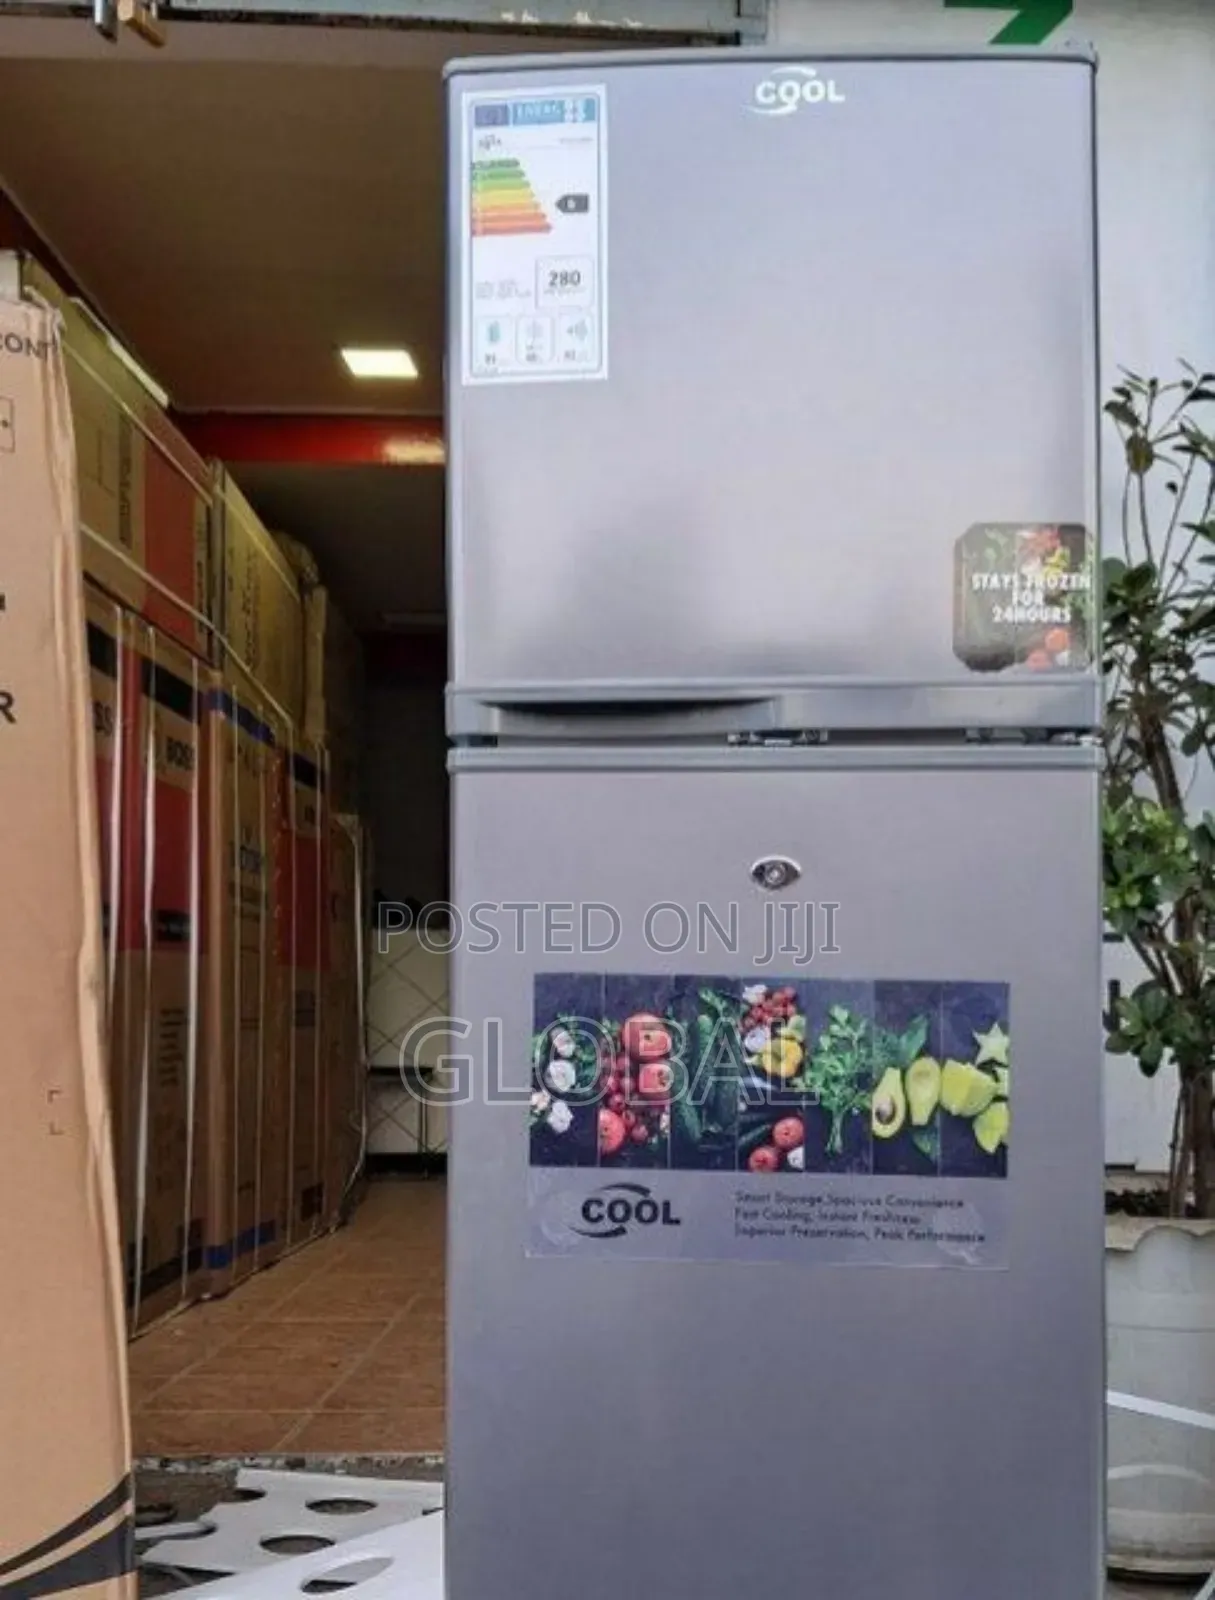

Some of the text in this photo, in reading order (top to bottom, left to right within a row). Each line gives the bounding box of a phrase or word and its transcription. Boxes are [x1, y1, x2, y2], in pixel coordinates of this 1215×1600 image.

[547, 269, 582, 287] 280
[1011, 589, 1044, 606] FOR
[581, 1197, 682, 1226] COOL
